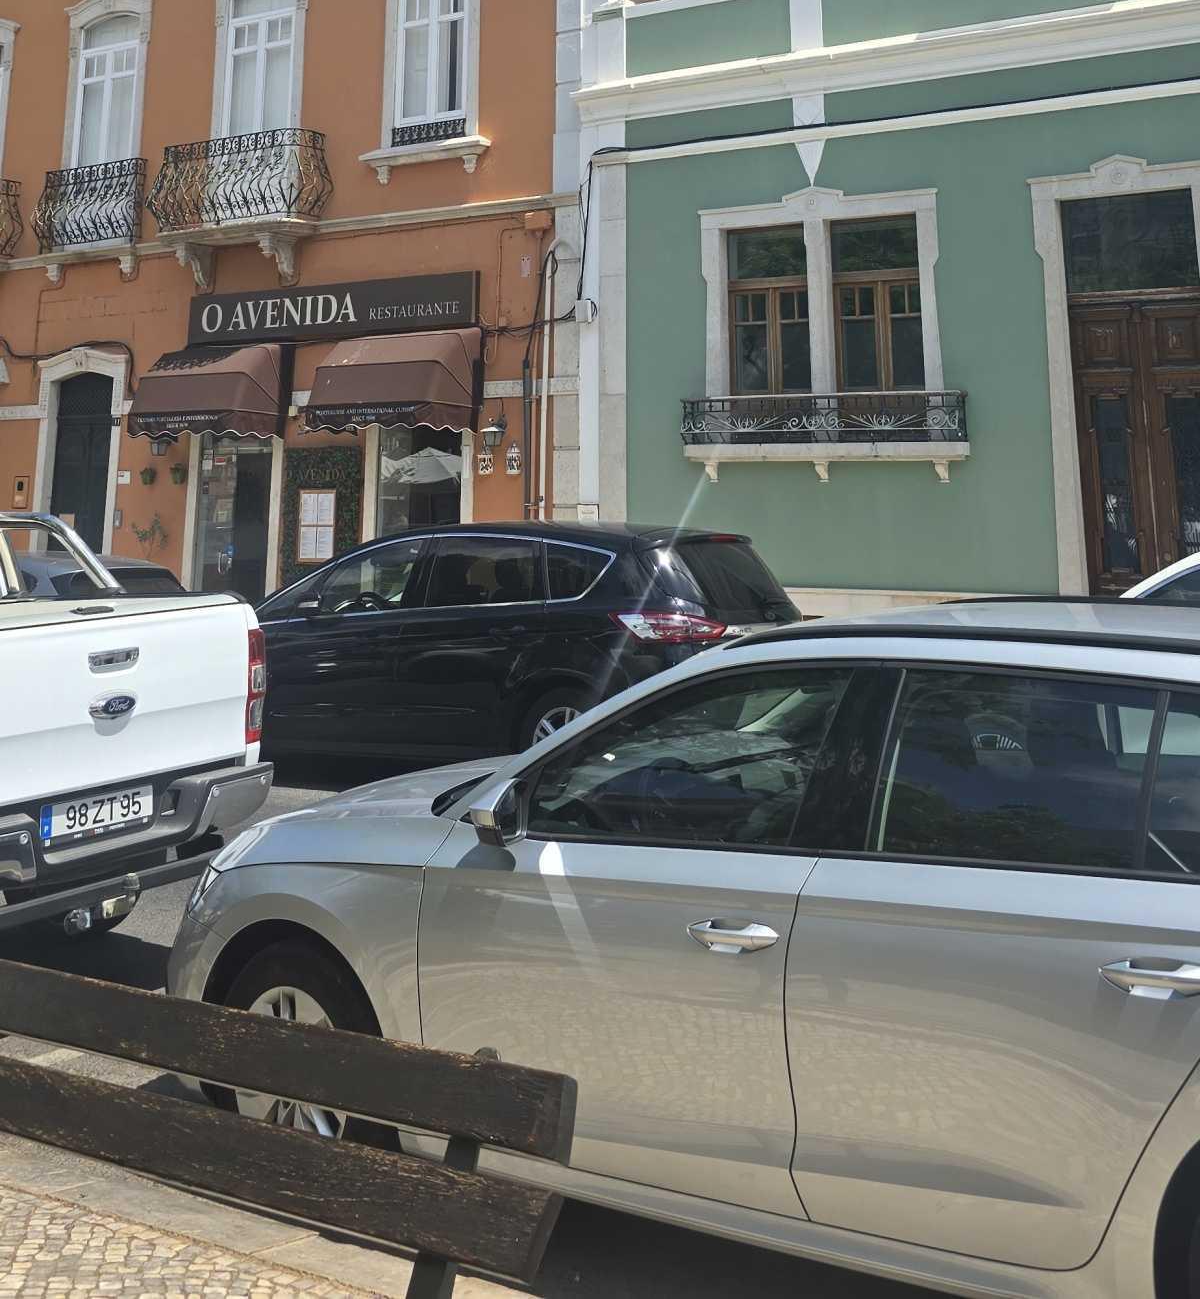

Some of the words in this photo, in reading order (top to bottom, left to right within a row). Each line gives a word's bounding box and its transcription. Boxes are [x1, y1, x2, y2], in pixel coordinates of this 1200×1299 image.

[201, 303, 223, 333] O
[227, 292, 358, 332] AVENIDA
[368, 300, 460, 320] RESTAURANTE
[109, 699, 130, 712] Ford
[66, 803, 89, 830] 98
[92, 797, 117, 824] ZT
[120, 791, 142, 818] 95
